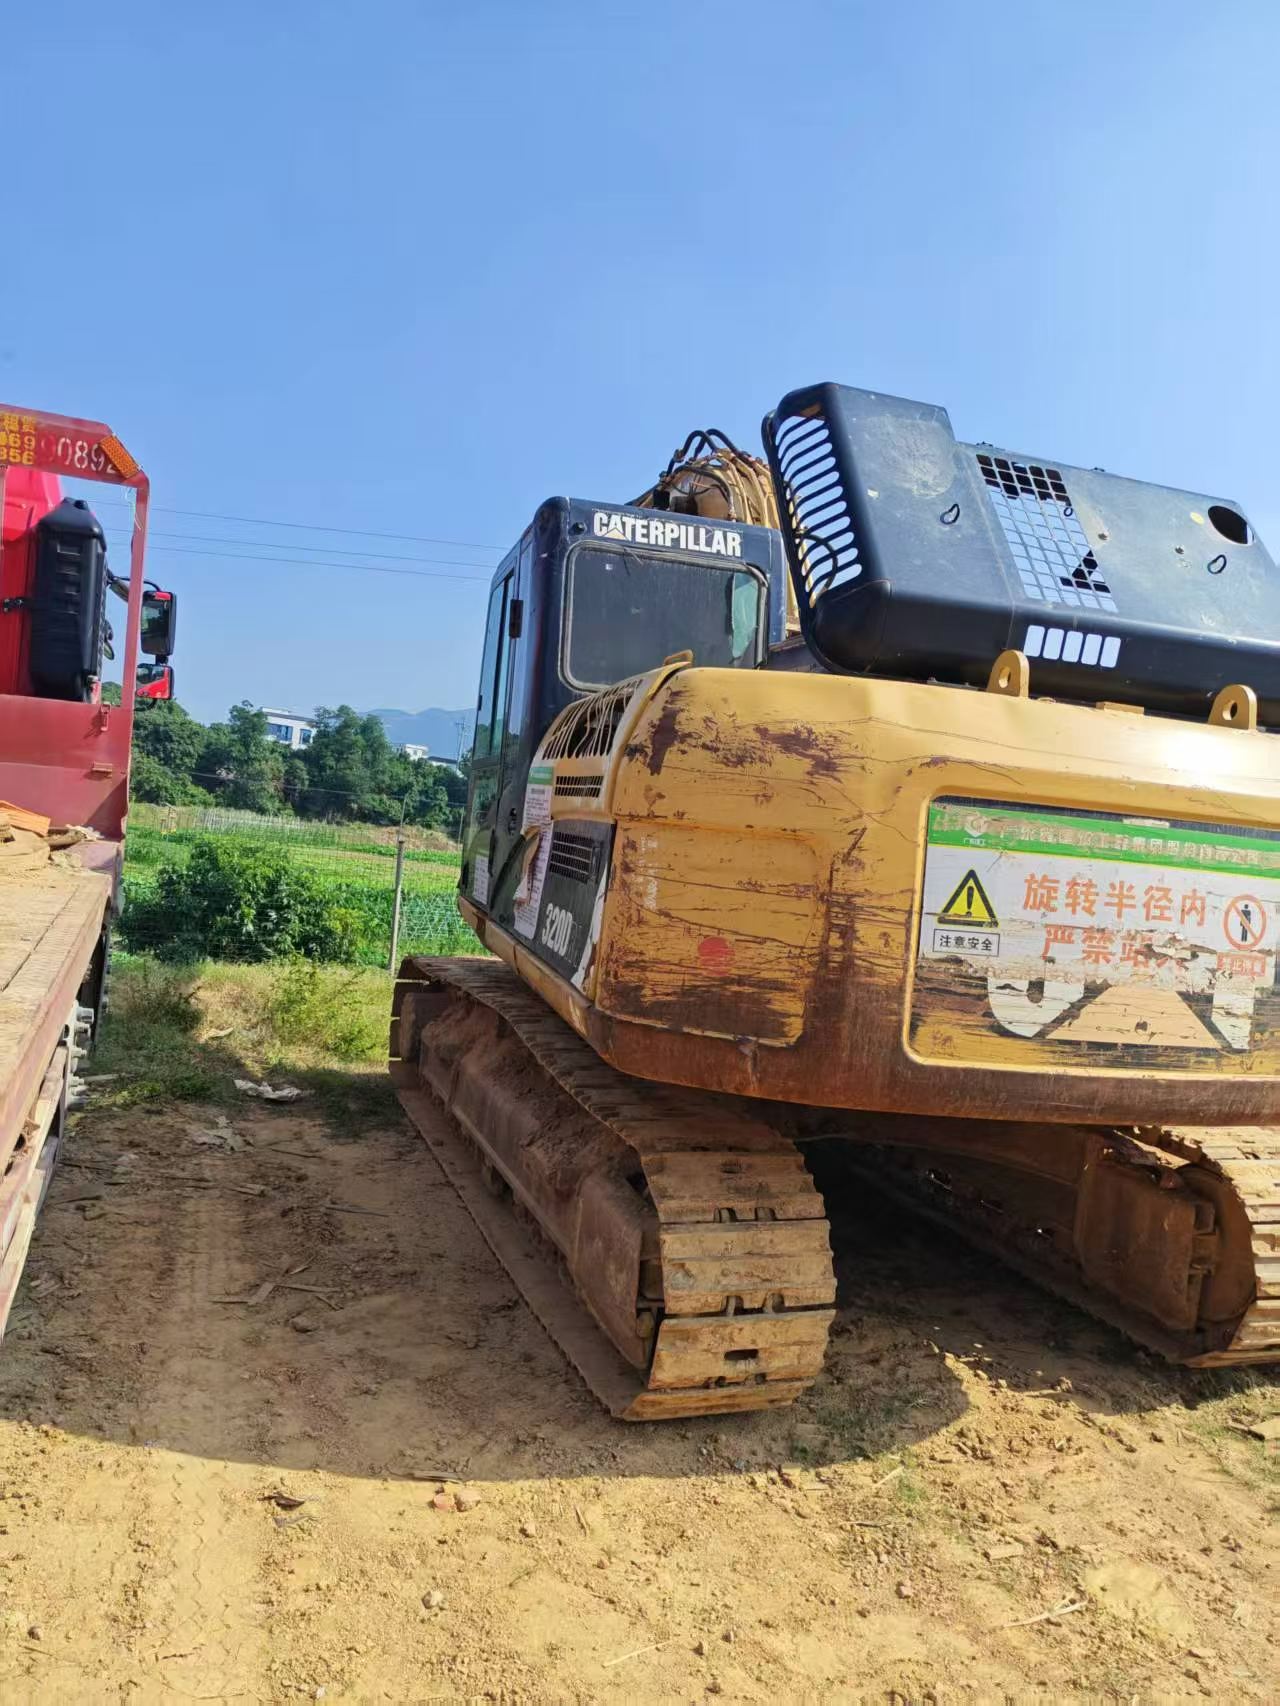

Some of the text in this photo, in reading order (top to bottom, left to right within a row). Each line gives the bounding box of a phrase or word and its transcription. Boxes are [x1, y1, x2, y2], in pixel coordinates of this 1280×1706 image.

[593, 512, 742, 557] CATERPILLAR
[1023, 873, 1206, 926] 旋转半径内
[939, 935, 992, 951] 注意安全
